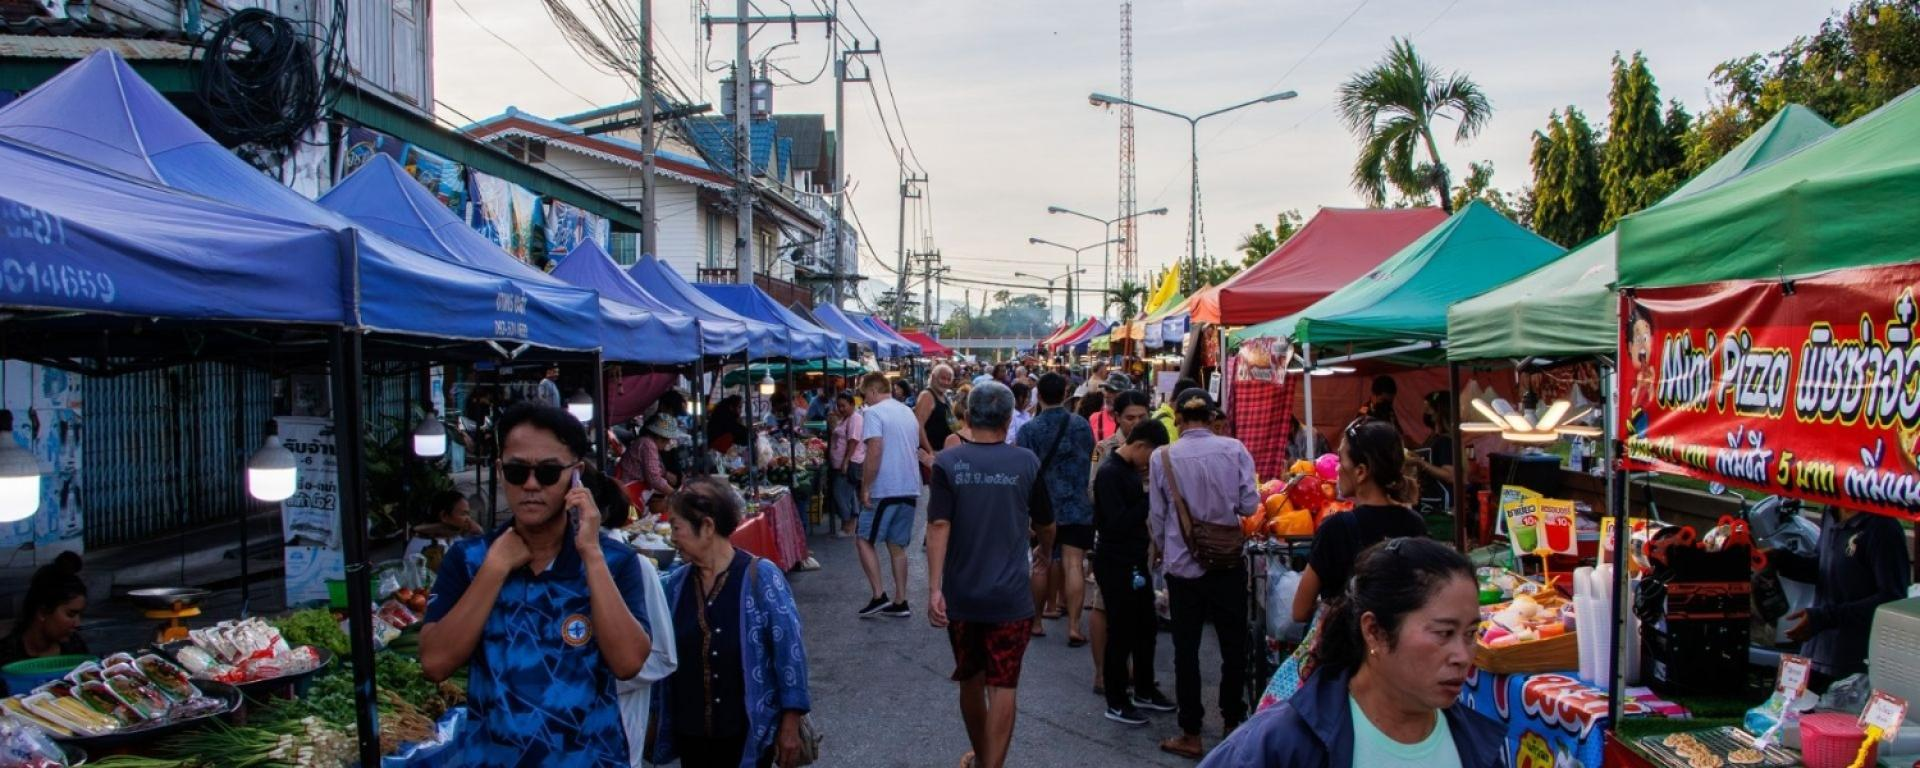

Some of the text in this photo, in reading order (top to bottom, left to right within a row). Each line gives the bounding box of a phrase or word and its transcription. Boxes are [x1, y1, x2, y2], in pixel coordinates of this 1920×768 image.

[0, 257, 116, 304] 014659
[1658, 329, 1717, 410] Mini
[1719, 329, 1791, 417] Pizza
[1776, 450, 1793, 486] 5
[1796, 460, 1837, 494] บาท
